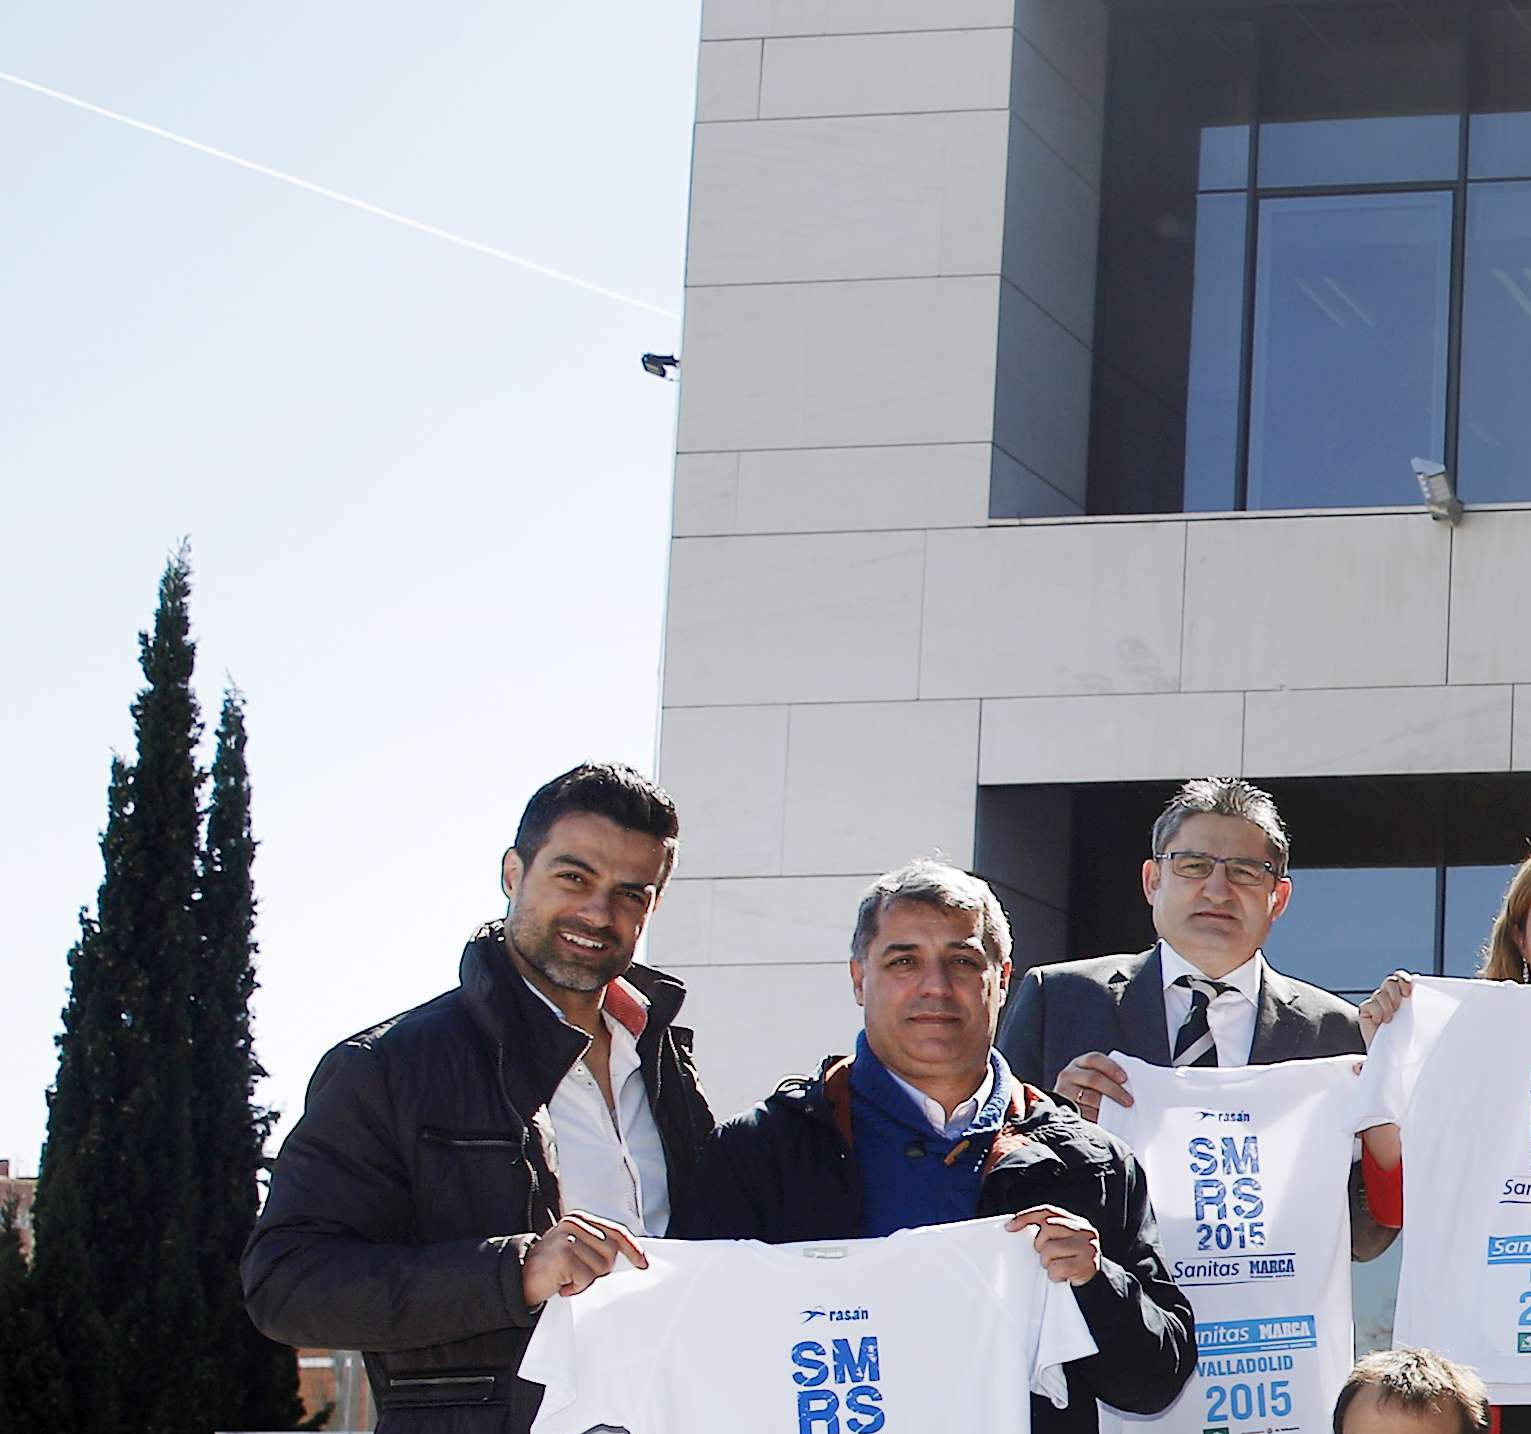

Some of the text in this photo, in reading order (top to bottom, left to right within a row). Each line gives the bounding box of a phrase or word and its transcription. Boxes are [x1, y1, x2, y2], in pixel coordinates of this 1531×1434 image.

[1188, 1136, 1260, 1176] SM
[1193, 1177, 1265, 1222] RS
[1196, 1222, 1266, 1251] 2015
[1173, 1258, 1295, 1279] Sanitas MARCA
[1258, 1321, 1311, 1340] MARCA
[791, 1336, 880, 1387] SM
[1197, 1354, 1294, 1378] VALLADOLID
[1206, 1380, 1292, 1423] 2015
